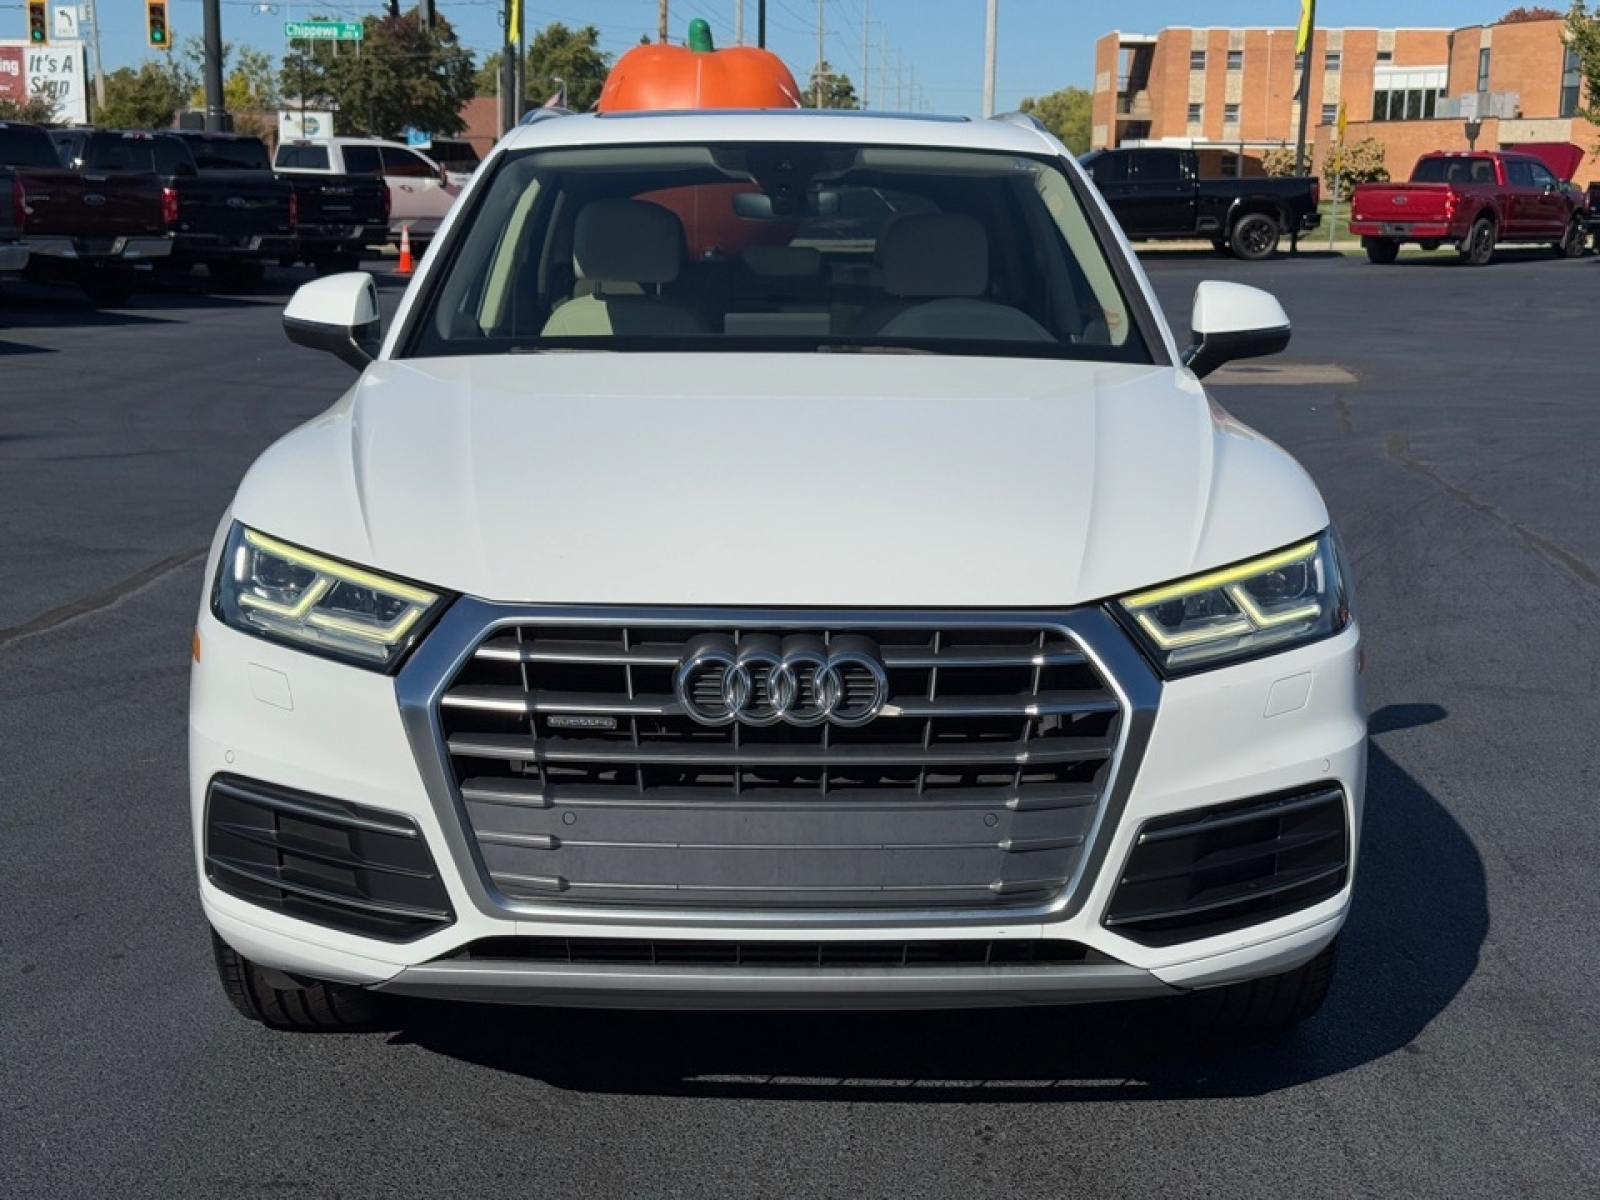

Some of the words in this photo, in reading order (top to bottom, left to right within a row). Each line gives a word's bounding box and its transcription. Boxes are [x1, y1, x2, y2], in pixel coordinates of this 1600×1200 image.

[286, 24, 338, 38] Chippewa
[29, 54, 57, 73] It's
[62, 54, 73, 73] A
[30, 75, 70, 99] Sign
